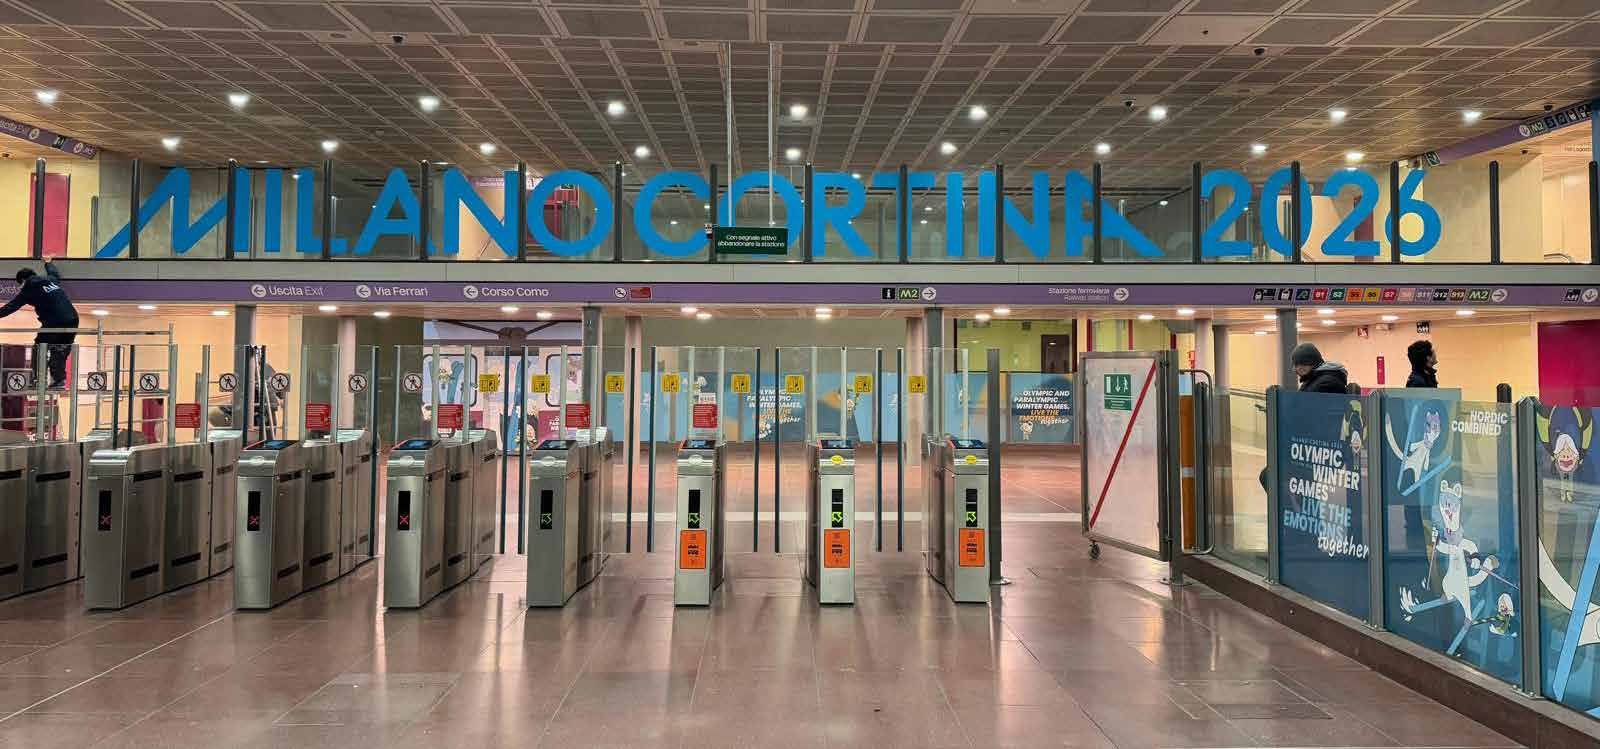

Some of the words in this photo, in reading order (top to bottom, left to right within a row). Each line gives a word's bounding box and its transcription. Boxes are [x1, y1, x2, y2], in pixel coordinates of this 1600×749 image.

[95, 167, 613, 258] MILANO
[634, 170, 1166, 260] CORTINA
[1200, 169, 1442, 257] 2026
[268, 285, 303, 296] Uscita
[305, 286, 324, 296] Exit
[374, 286, 391, 296] Via
[392, 286, 428, 296] Ferrari
[481, 287, 515, 297] Corso
[517, 287, 549, 297] Como
[900, 289, 918, 298] M2
[1469, 291, 1488, 299] M2
[1471, 410, 1508, 424] NORDIC
[1451, 420, 1502, 436] COMBINED
[1290, 443, 1343, 467] OLYMPIC
[1312, 464, 1360, 491] WINTER
[1302, 496, 1327, 520] LIVE
[1328, 503, 1352, 528] THE
[1283, 509, 1348, 540] EMOTIONS
[1317, 535, 1370, 559] together
